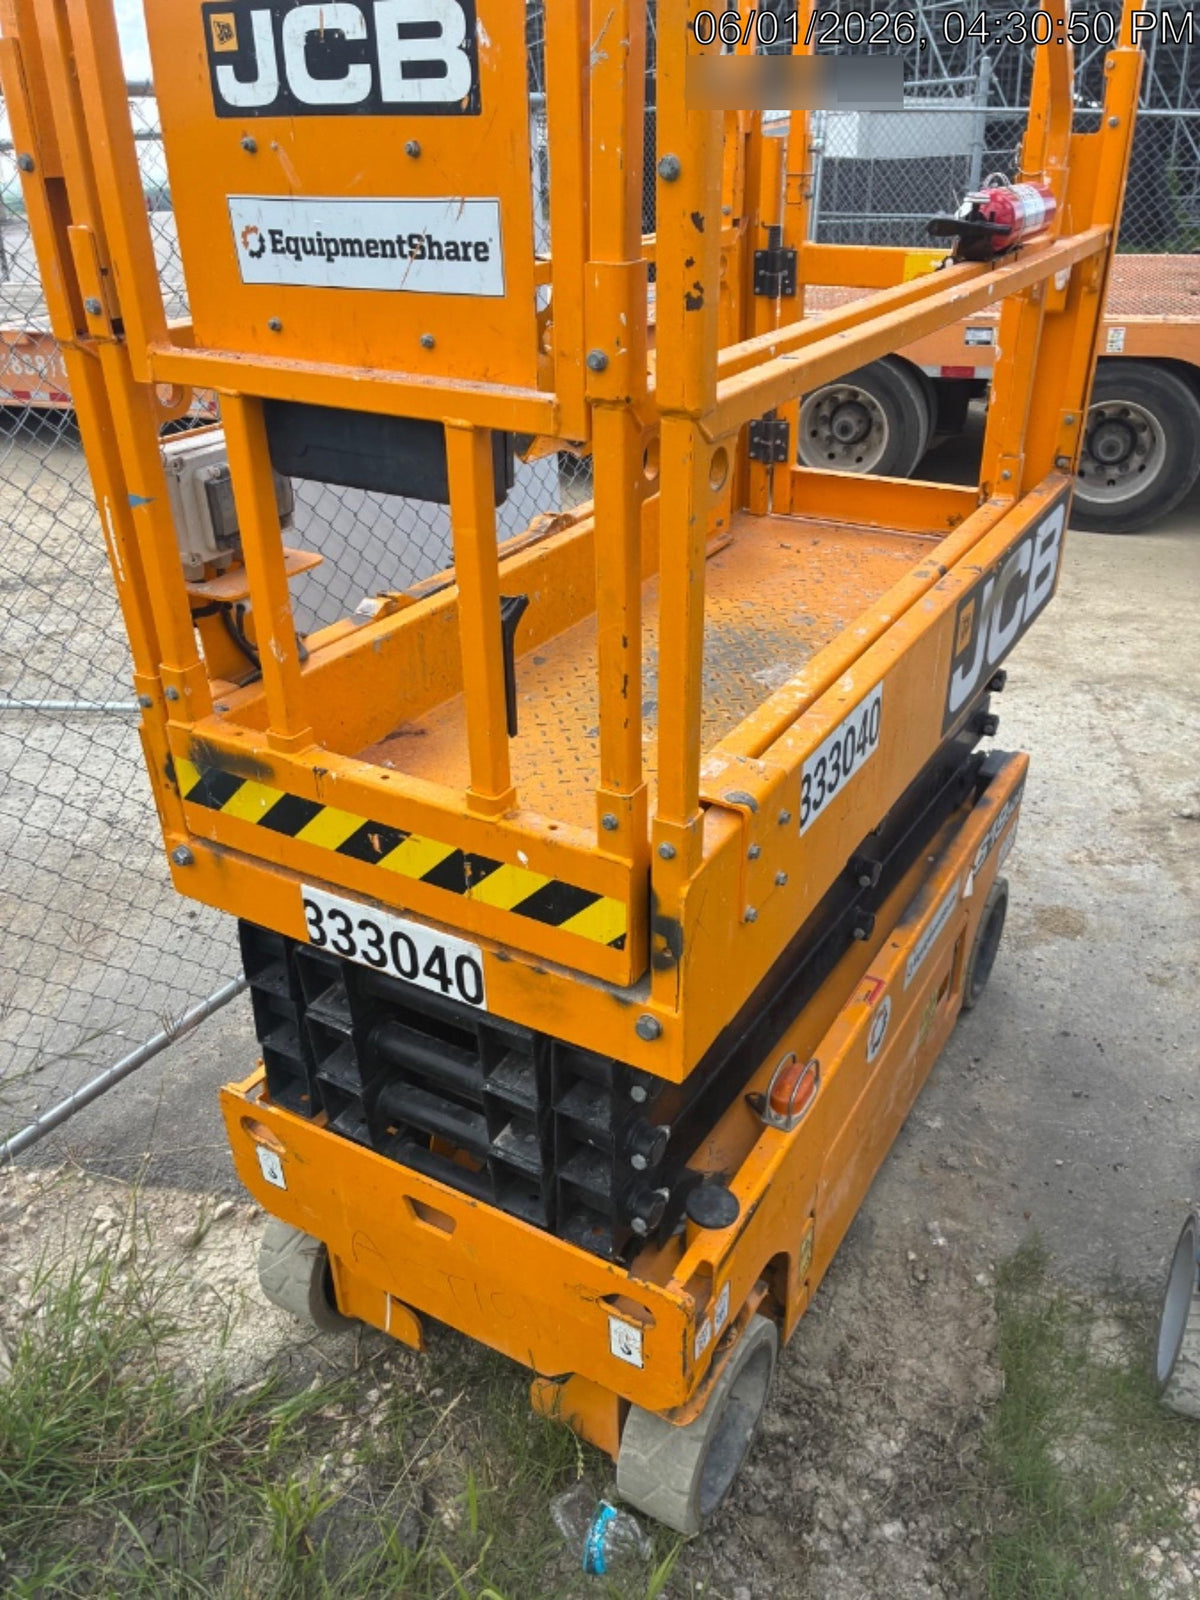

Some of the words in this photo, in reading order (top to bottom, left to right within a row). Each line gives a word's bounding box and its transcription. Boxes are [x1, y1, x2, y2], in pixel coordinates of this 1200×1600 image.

[216, 1, 472, 107] JCB
[267, 229, 490, 263] EquipmentShare
[949, 504, 1065, 712] JCB
[800, 696, 882, 829] 333040
[303, 899, 485, 1005] 333040
